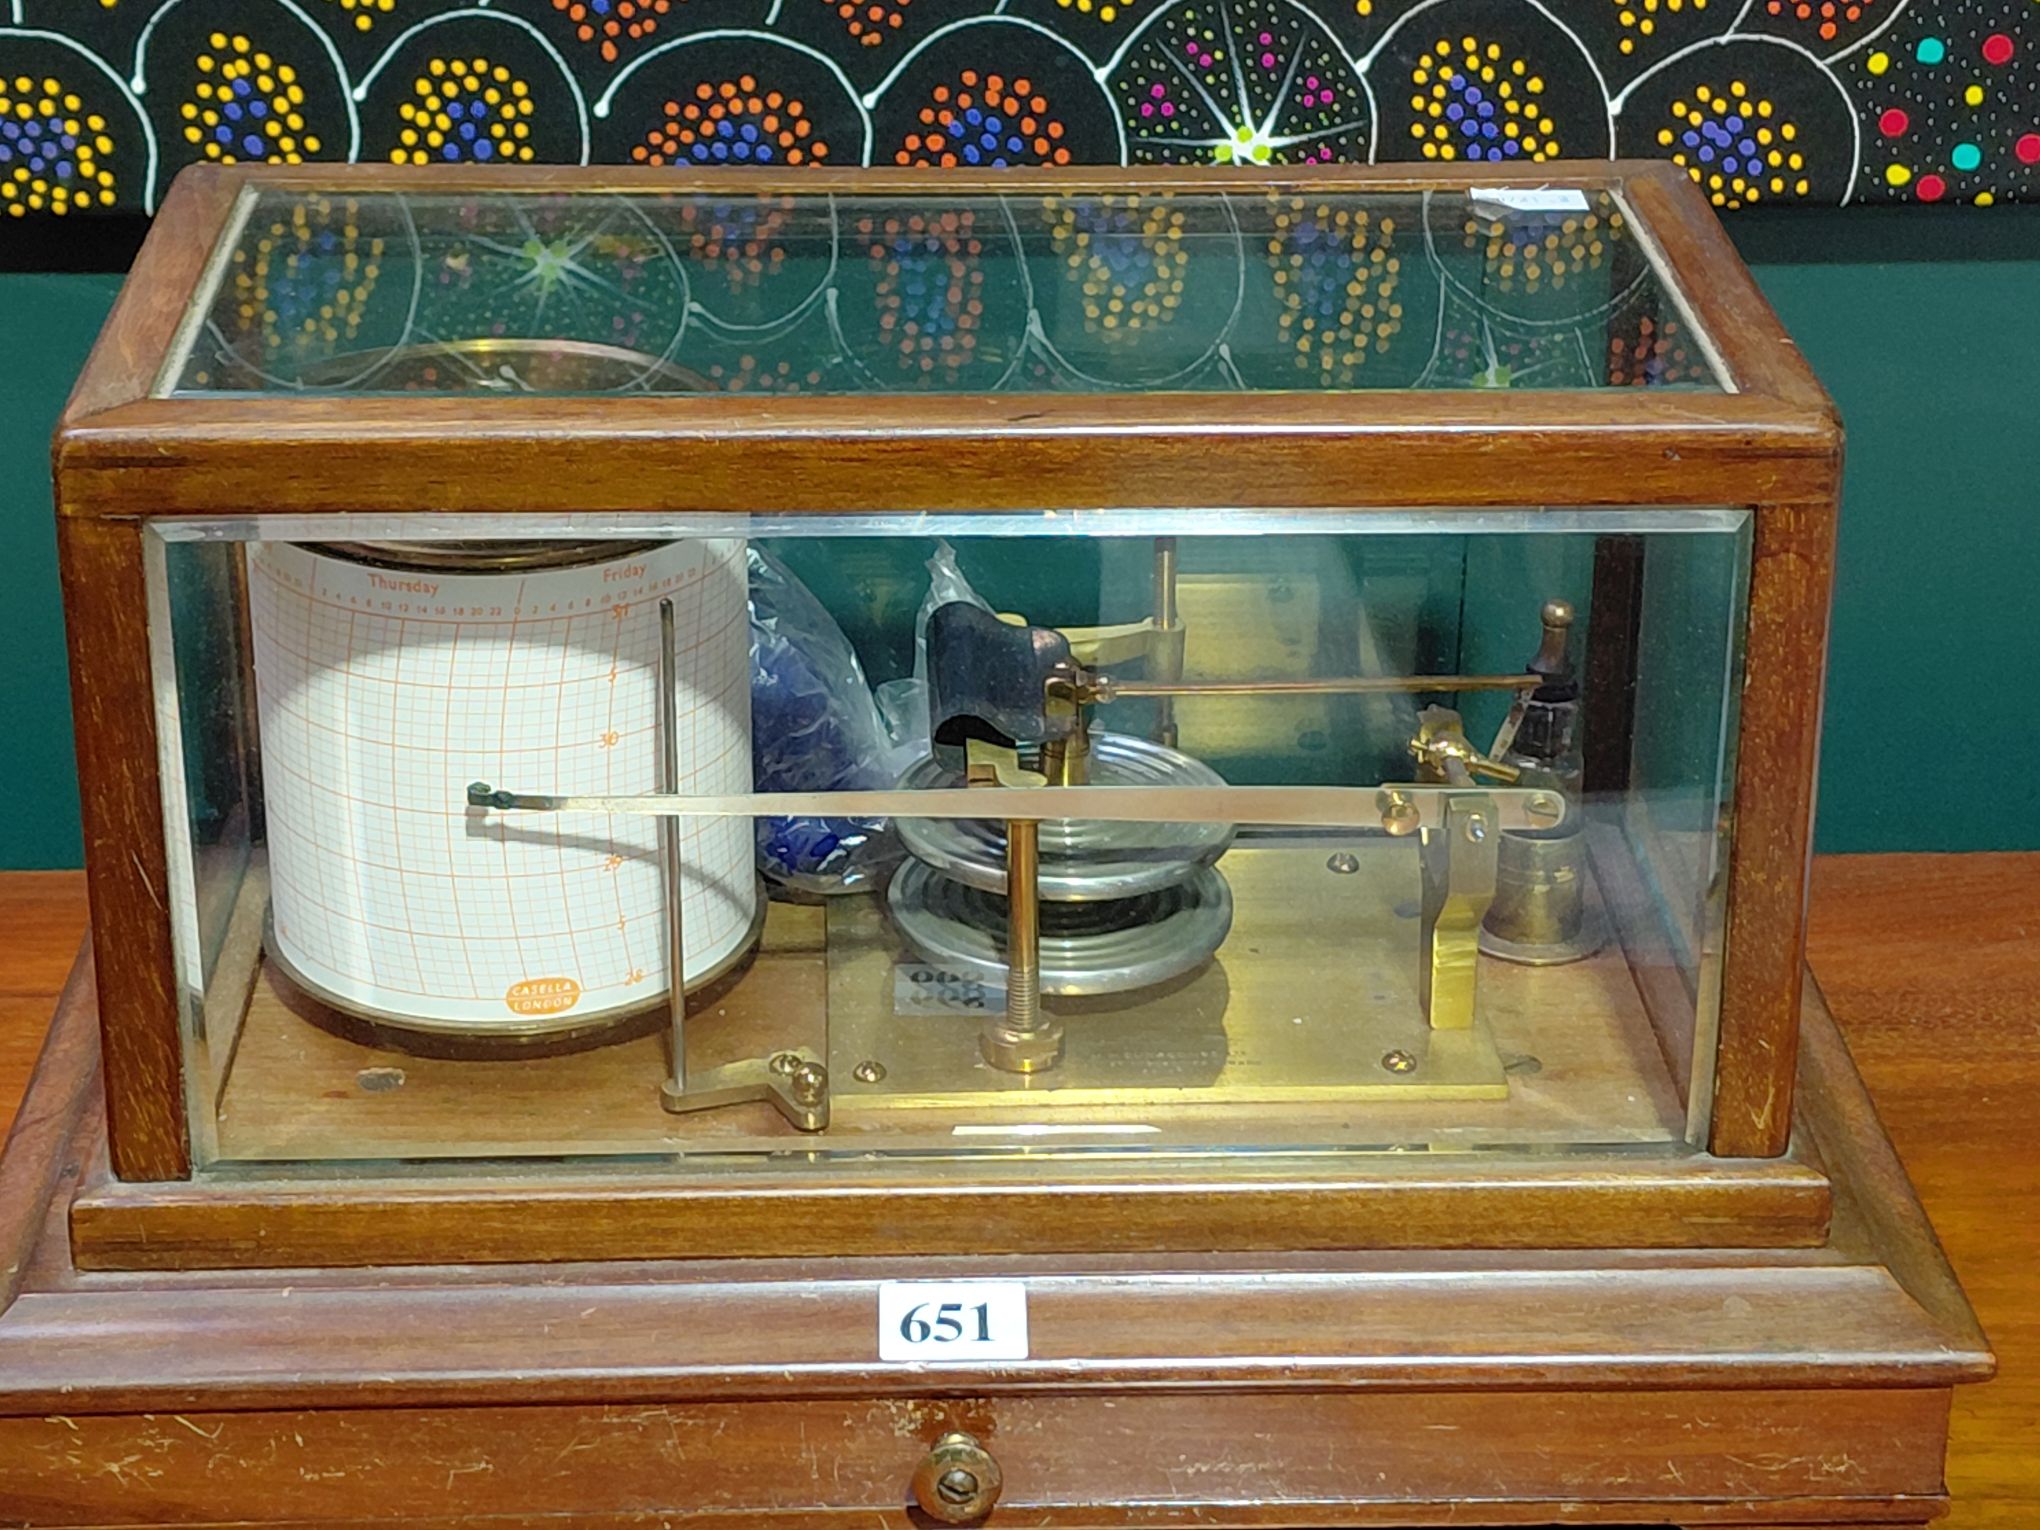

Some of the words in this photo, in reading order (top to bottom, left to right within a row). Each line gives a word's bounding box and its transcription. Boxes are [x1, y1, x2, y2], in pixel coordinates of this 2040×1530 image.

[603, 564, 647, 583] Friday
[367, 573, 439, 598] Thursday
[453, 607, 464, 616] 18
[512, 981, 571, 996] CASELLA
[514, 997, 572, 1011] LONDON
[900, 1302, 995, 1344] 651
